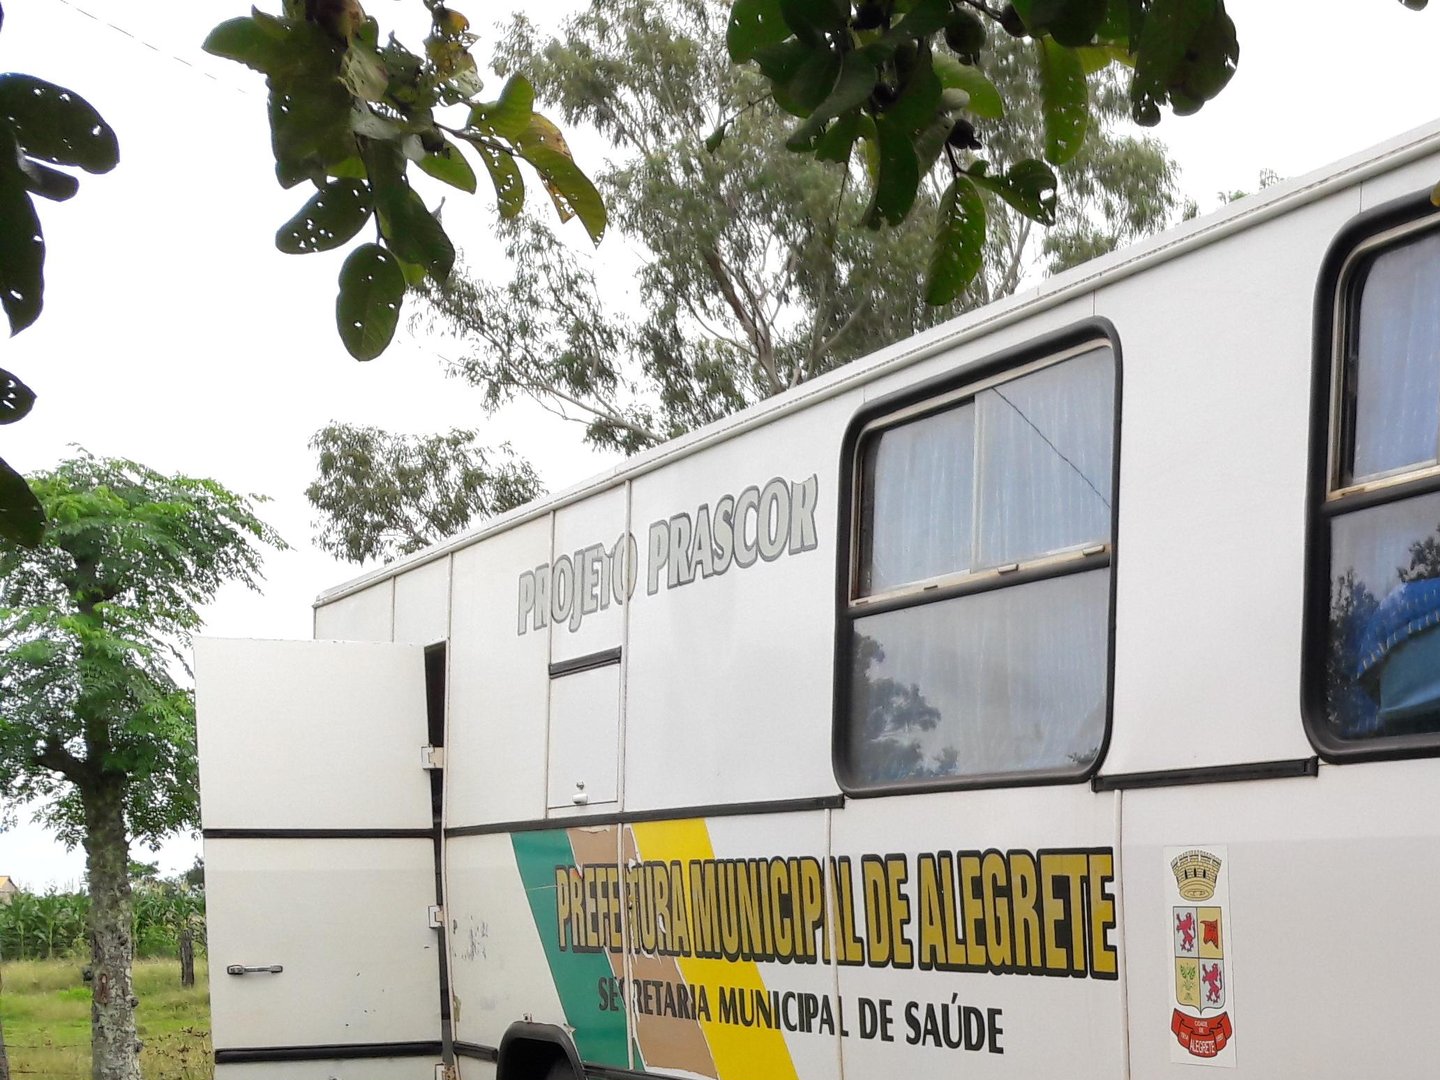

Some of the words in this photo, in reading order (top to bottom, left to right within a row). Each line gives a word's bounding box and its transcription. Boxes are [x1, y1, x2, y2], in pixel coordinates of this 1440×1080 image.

[517, 532, 638, 636] PROJETO
[648, 473, 818, 596] PRASCOR
[689, 855, 865, 967] MUNICIPAL
[861, 853, 914, 969] DE
[917, 847, 1119, 981] ALEGRETE
[718, 986, 849, 1037] MUNICIPAL
[858, 997, 895, 1042] DE
[904, 992, 1004, 1055] SAÚDE
